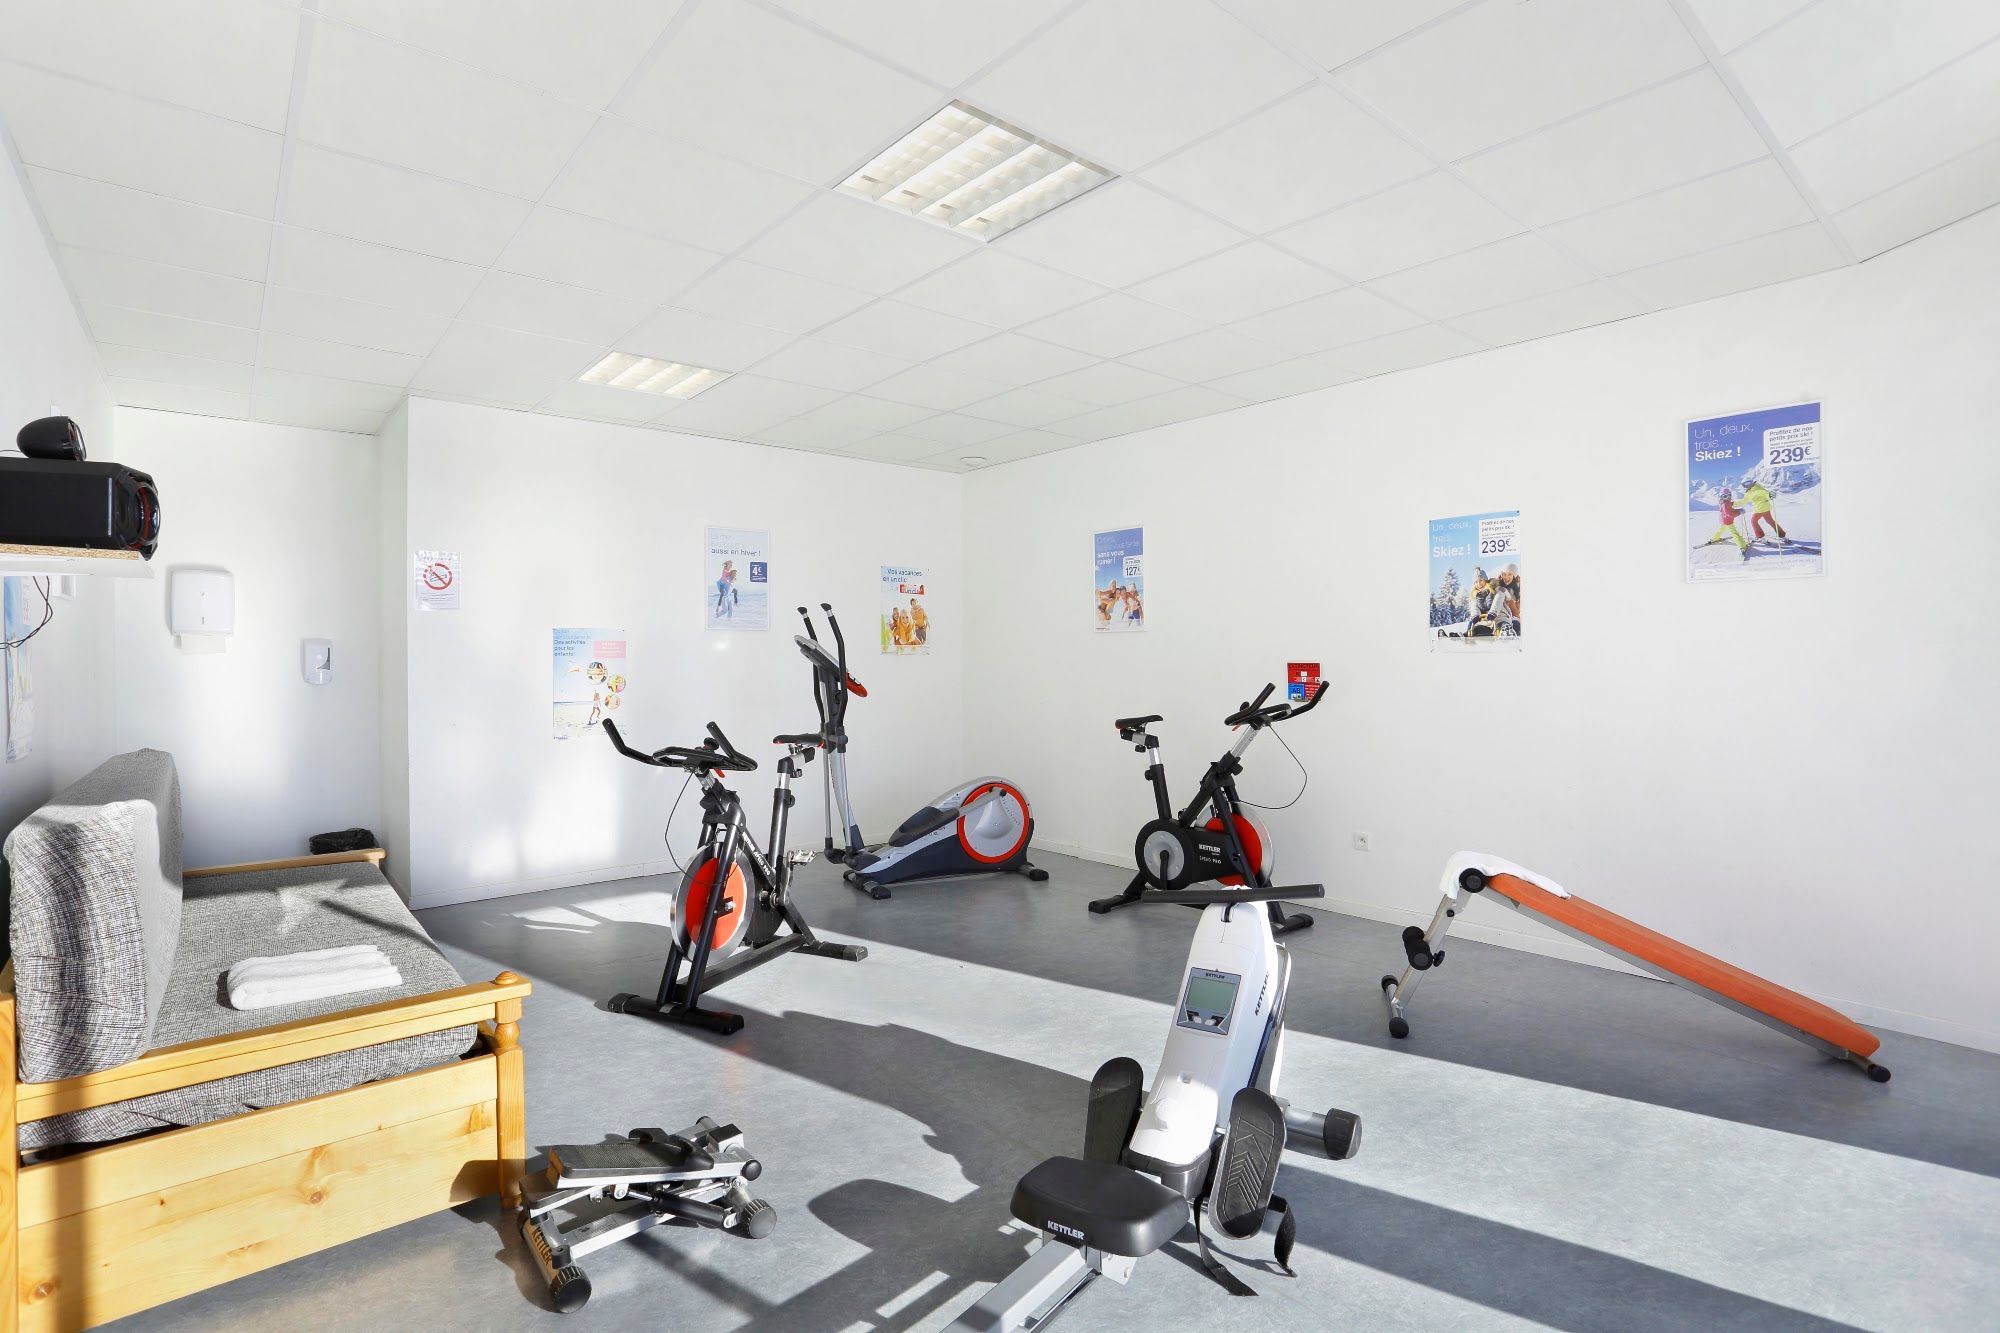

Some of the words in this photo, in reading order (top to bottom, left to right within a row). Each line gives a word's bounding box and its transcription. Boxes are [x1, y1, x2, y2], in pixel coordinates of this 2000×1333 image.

[1694, 428, 1715, 439] Un,
[1719, 423, 1754, 436] deux,
[1695, 448, 1732, 462] Skiez
[1737, 446, 1741, 457] !
[1769, 445, 1812, 466] 239€
[740, 548, 757, 557] hiver
[1433, 545, 1464, 558] Skiez
[1047, 1220, 1085, 1241] KETTLER
